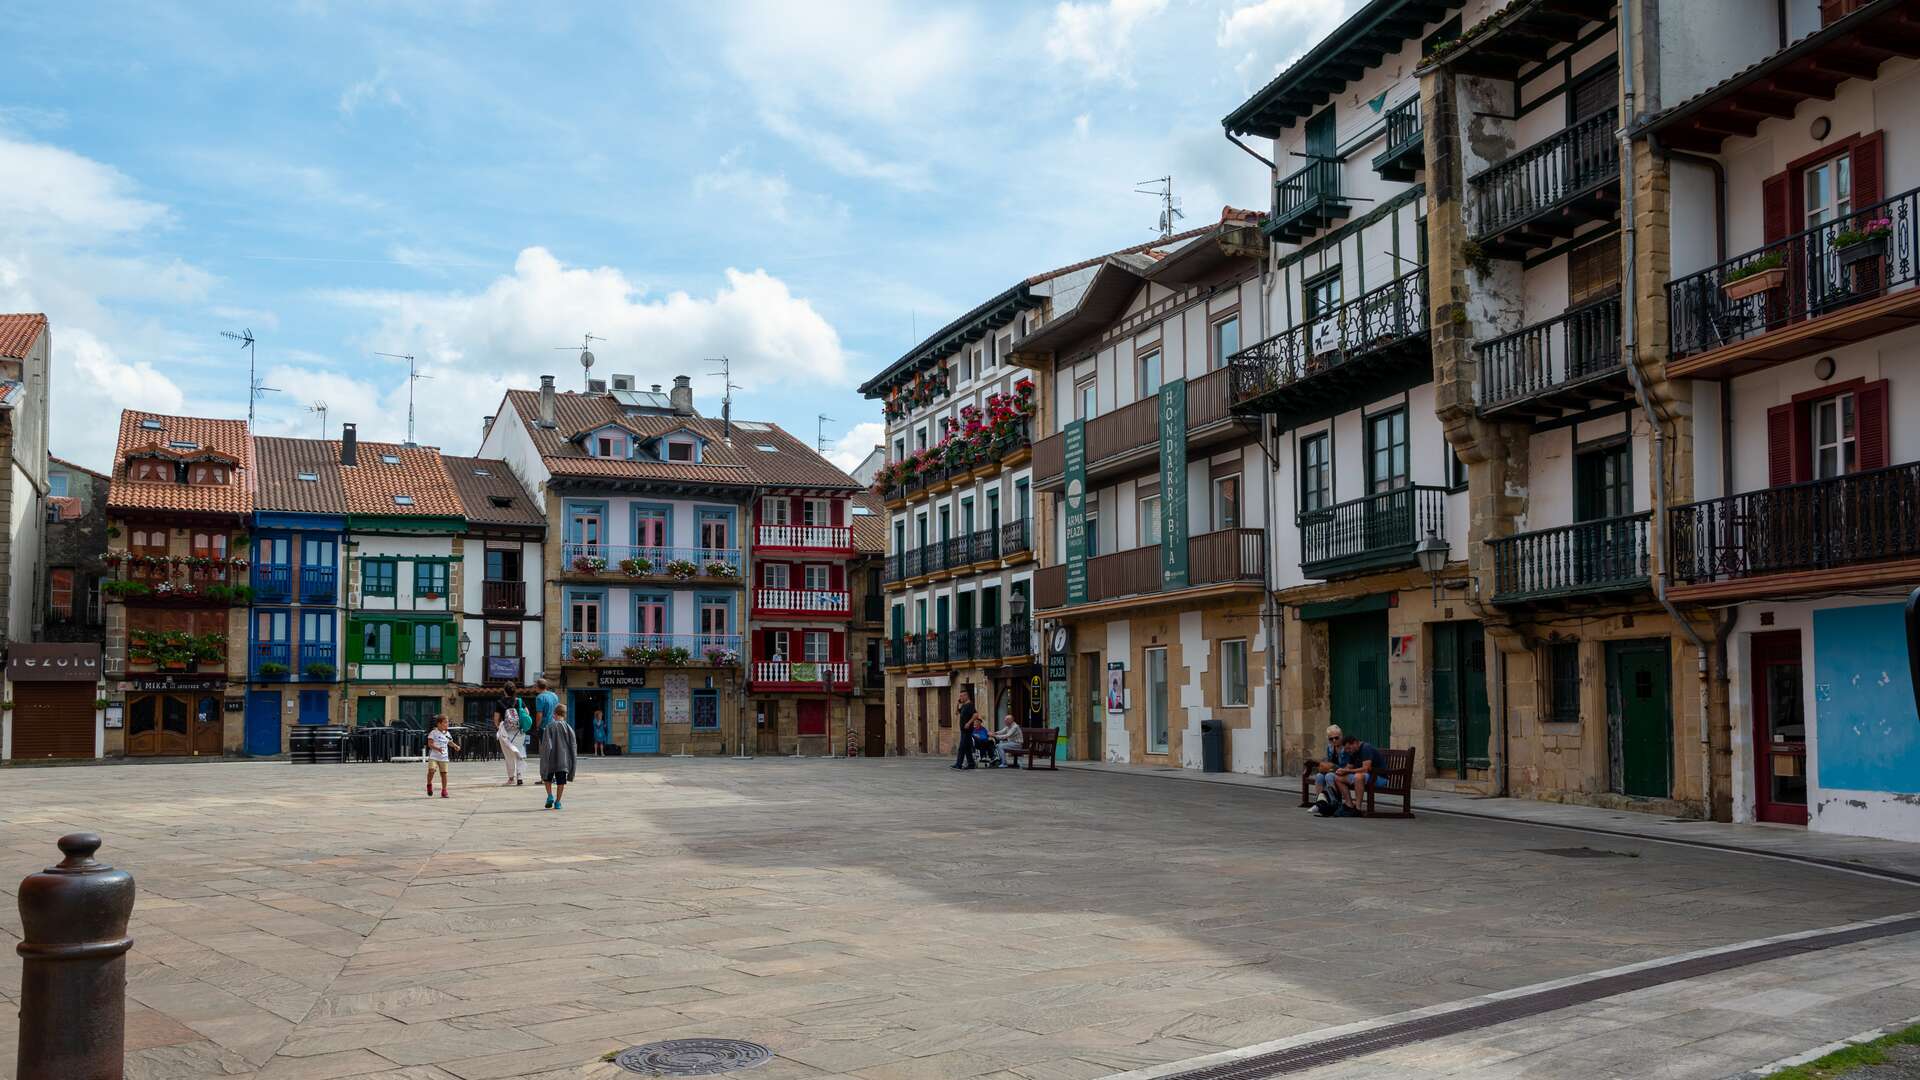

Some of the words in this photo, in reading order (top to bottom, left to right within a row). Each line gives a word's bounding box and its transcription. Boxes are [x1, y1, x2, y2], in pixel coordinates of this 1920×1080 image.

[1166, 391, 1175, 565] HONDARRIBIA
[1067, 513, 1084, 526] ARMA
[1067, 525, 1084, 539] PLAZA
[600, 677, 615, 685] SAN
